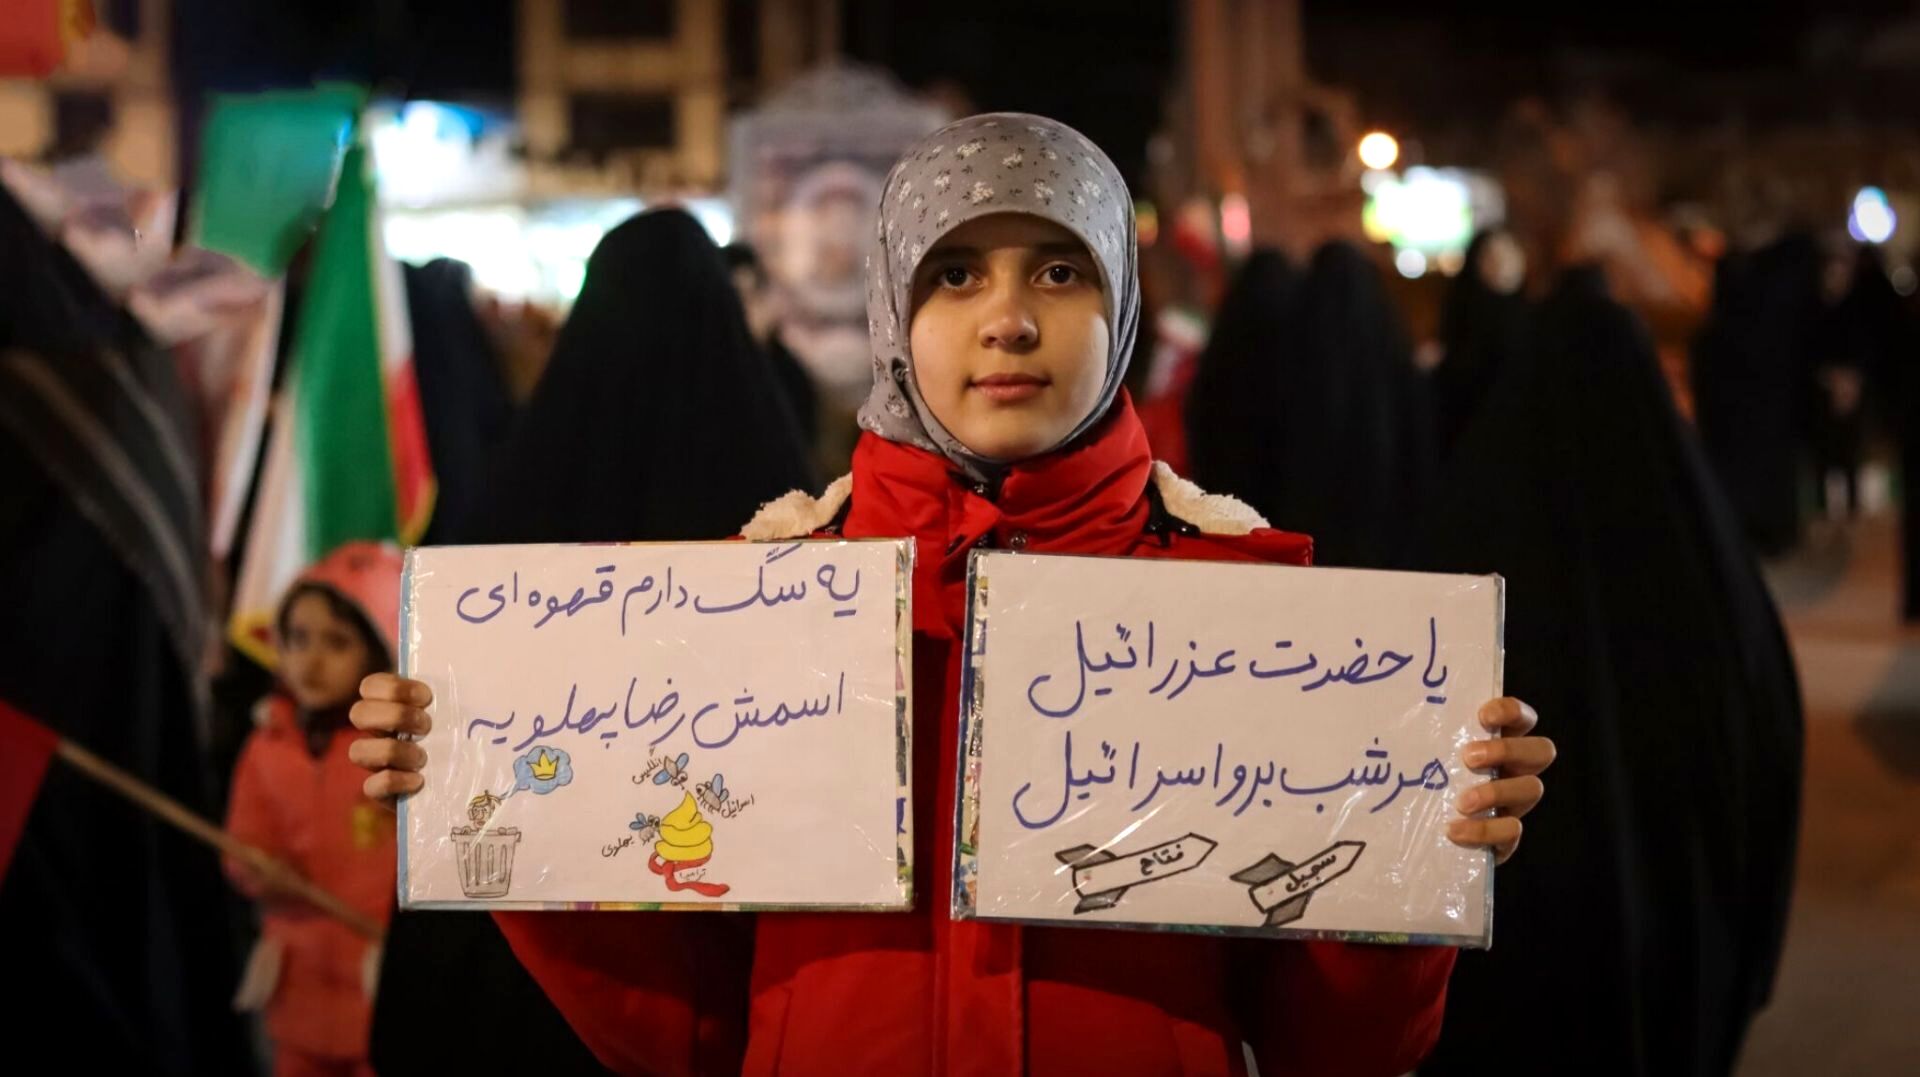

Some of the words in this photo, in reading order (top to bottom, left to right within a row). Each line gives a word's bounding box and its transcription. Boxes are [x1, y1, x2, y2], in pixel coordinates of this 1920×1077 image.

[622, 565, 689, 637] دارم
[694, 544, 807, 614] سگ
[816, 563, 860, 618] یه
[1027, 619, 1237, 719] عزرائیل
[1248, 637, 1414, 693] حضرت
[1422, 616, 1448, 705] یا
[624, 676, 686, 747] رضا
[690, 671, 845, 750] اسمش
[1012, 730, 1224, 830] اسرائیل
[1214, 760, 1275, 818] برو
[1279, 736, 1392, 814] شب
[1139, 843, 1184, 876] فتاح
[1285, 853, 1337, 893] سجیل
